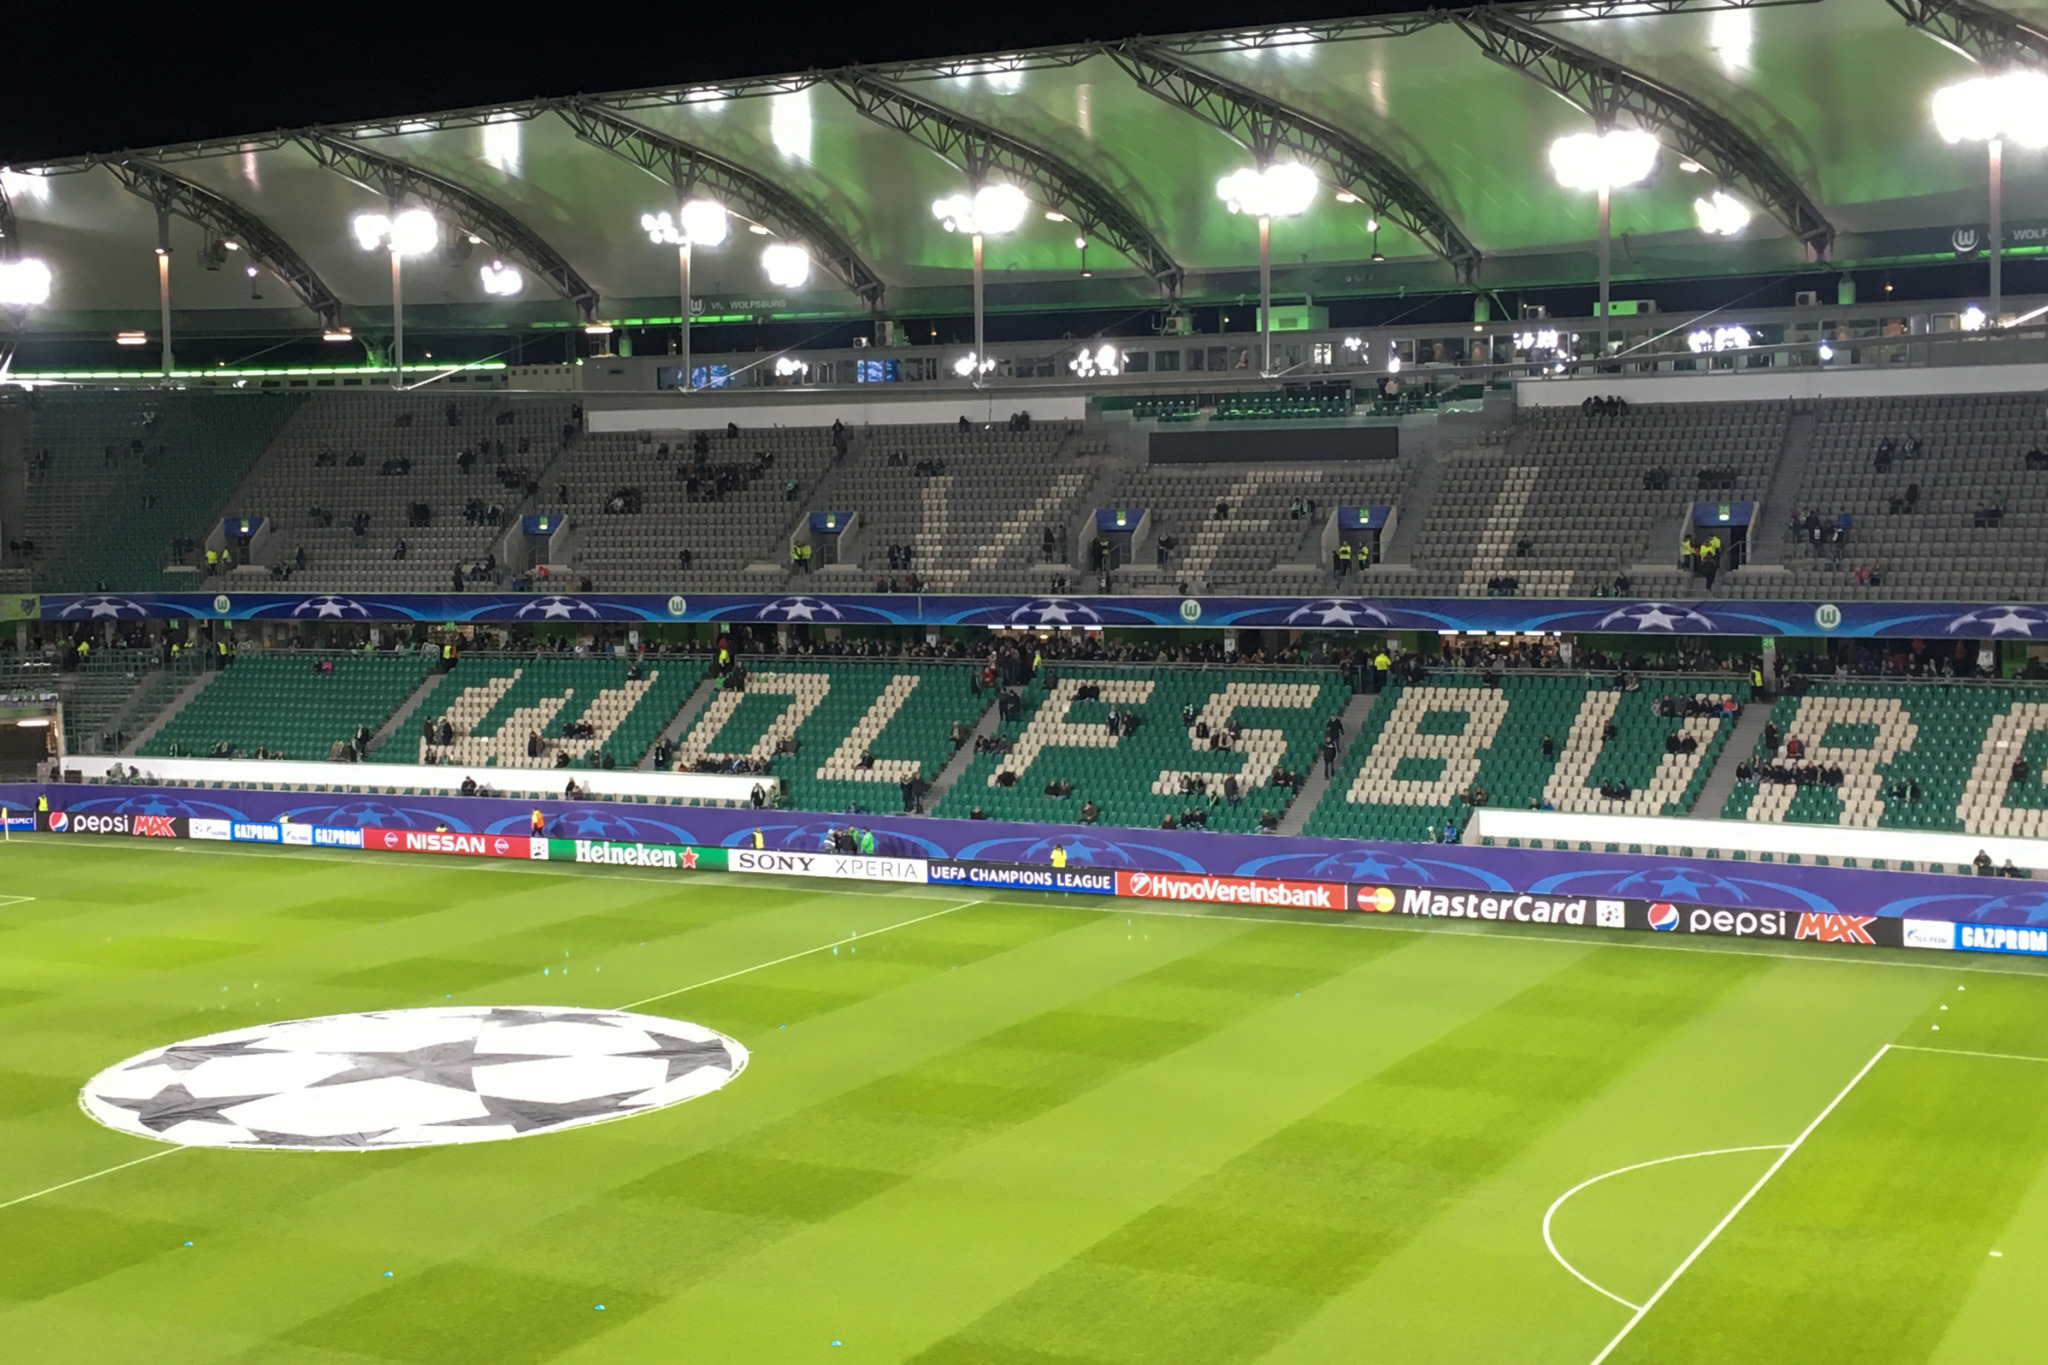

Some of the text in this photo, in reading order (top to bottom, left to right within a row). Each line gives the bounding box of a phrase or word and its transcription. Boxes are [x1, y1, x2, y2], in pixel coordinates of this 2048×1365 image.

[730, 299, 786, 309] WOLFSBURG
[7, 817, 34, 825] RESPECT
[73, 814, 177, 837] pepsi MAX
[234, 823, 279, 841] GAZPROM
[314, 828, 361, 846] GAZPROM
[406, 833, 486, 854] NISSAN
[575, 840, 677, 868] Heineken
[739, 852, 918, 879] SONY XPERIA
[931, 866, 1111, 889] UEFA CHAMPIONS LEAGUE
[1152, 875, 1332, 908] HypoVereinsbank
[1402, 889, 1587, 926] MasterCard
[1690, 908, 1878, 945] pepsi MAX
[1961, 926, 2047, 952] GAZPROM
